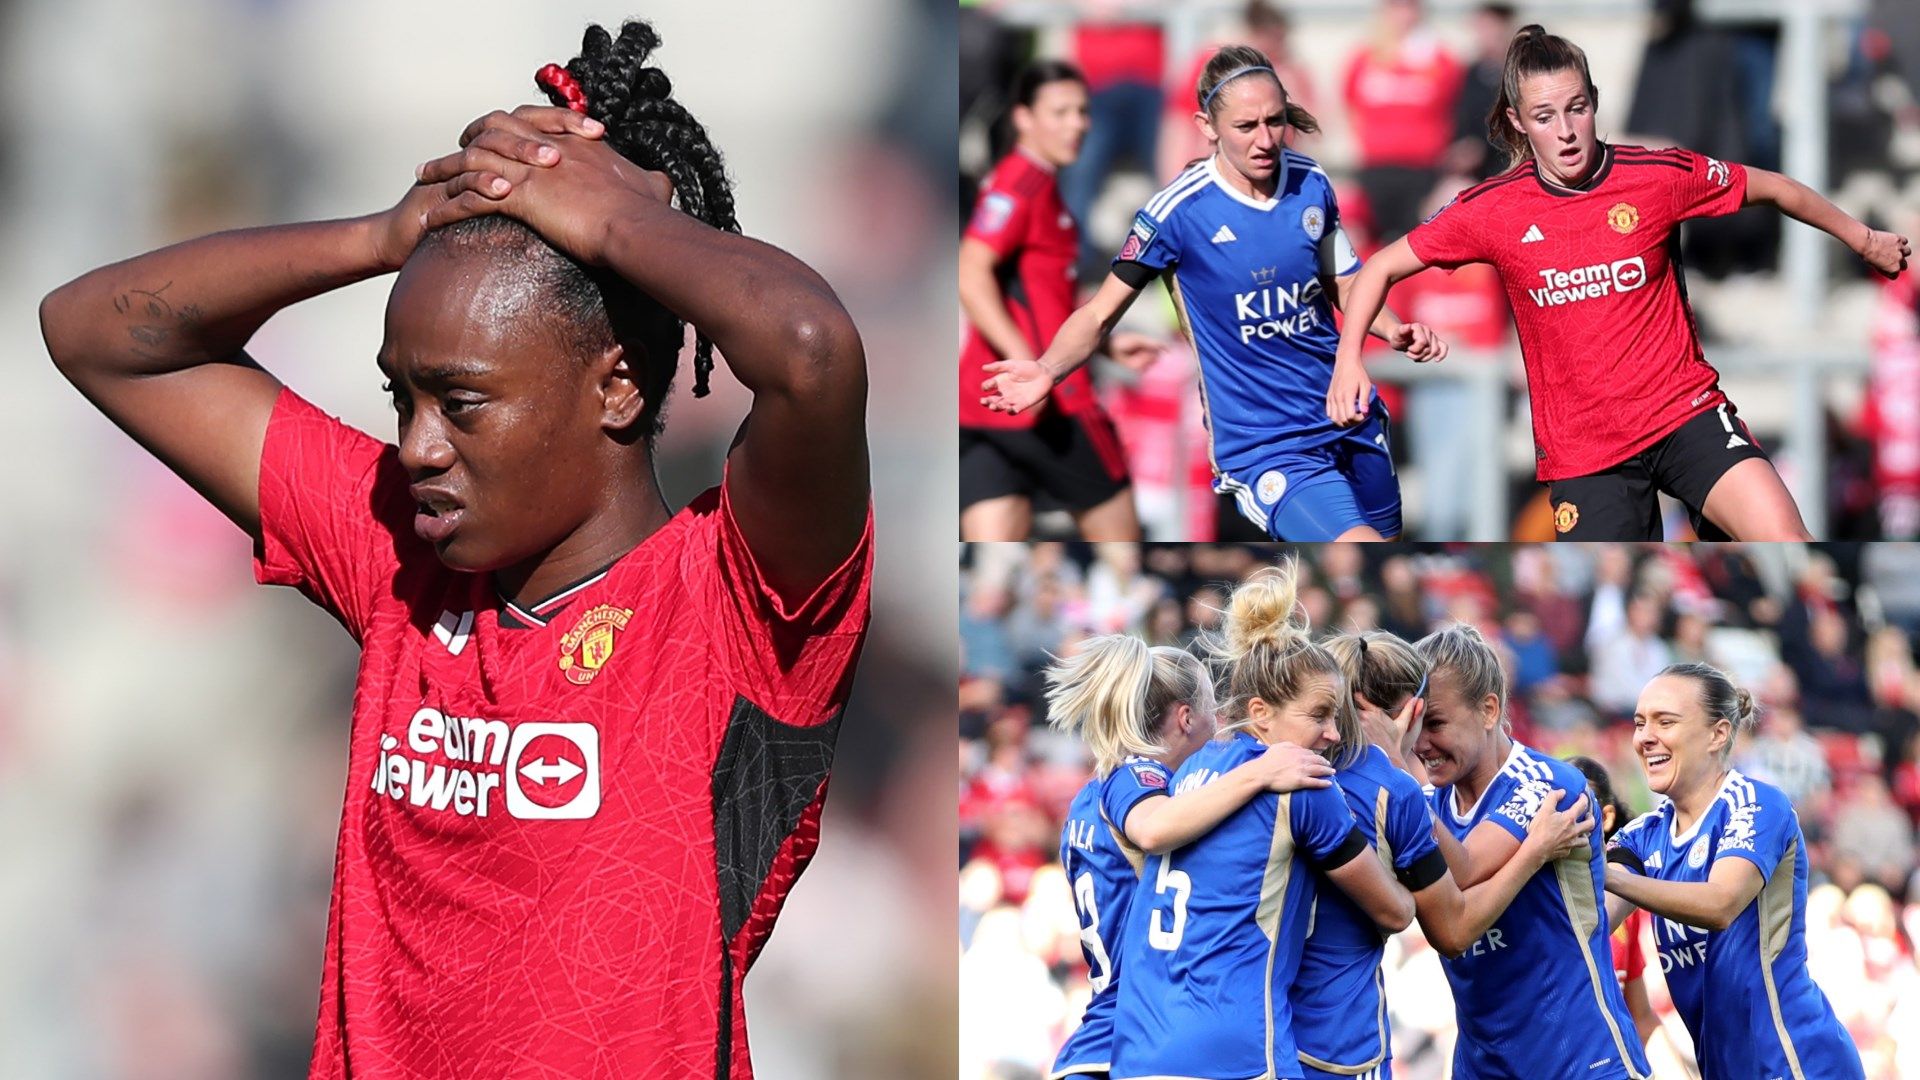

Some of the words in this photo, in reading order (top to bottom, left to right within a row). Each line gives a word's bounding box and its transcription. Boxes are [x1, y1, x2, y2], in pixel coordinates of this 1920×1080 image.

[1528, 280, 1612, 308] Viewer
[1539, 263, 1610, 290] Team
[1235, 277, 1322, 320] KING
[1240, 306, 1319, 345] POWER
[566, 610, 628, 649] MANCHESTER
[408, 707, 510, 765] eam
[1068, 819, 1094, 853] ALA
[1149, 851, 1192, 951] 5
[1658, 940, 1707, 974] OWE
